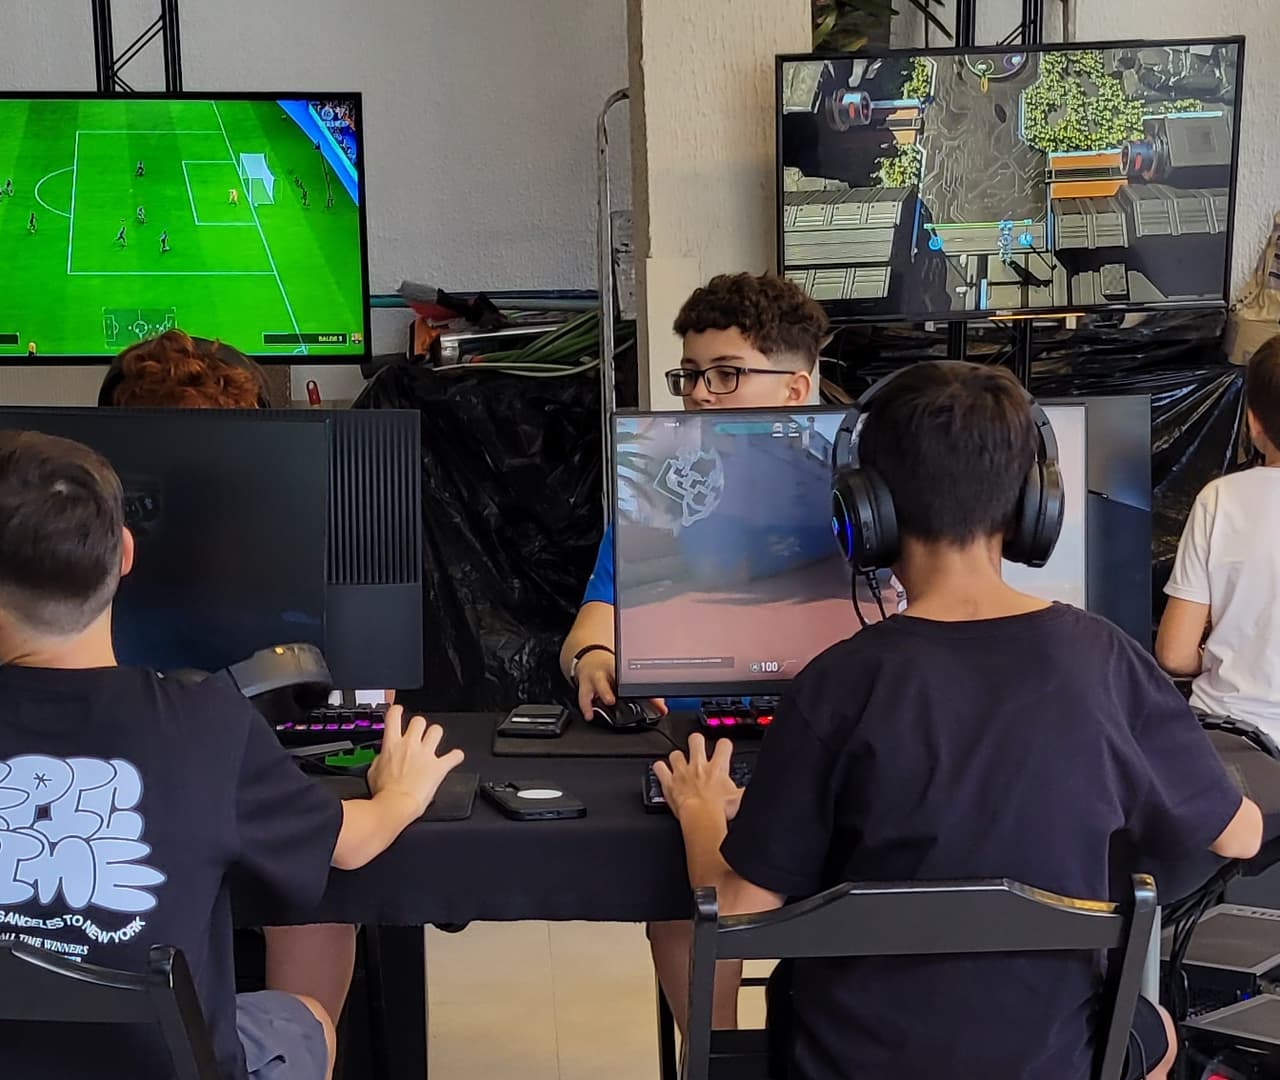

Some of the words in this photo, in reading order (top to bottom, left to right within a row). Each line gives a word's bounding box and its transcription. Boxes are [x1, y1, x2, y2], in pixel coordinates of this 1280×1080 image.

[760, 661, 779, 672] 100
[4, 912, 65, 930] ANGELES
[62, 914, 84, 927] TO
[82, 921, 111, 944] NEW
[109, 916, 146, 944] YORK
[19, 933, 44, 948] TIME
[43, 939, 90, 956] WINNERS
